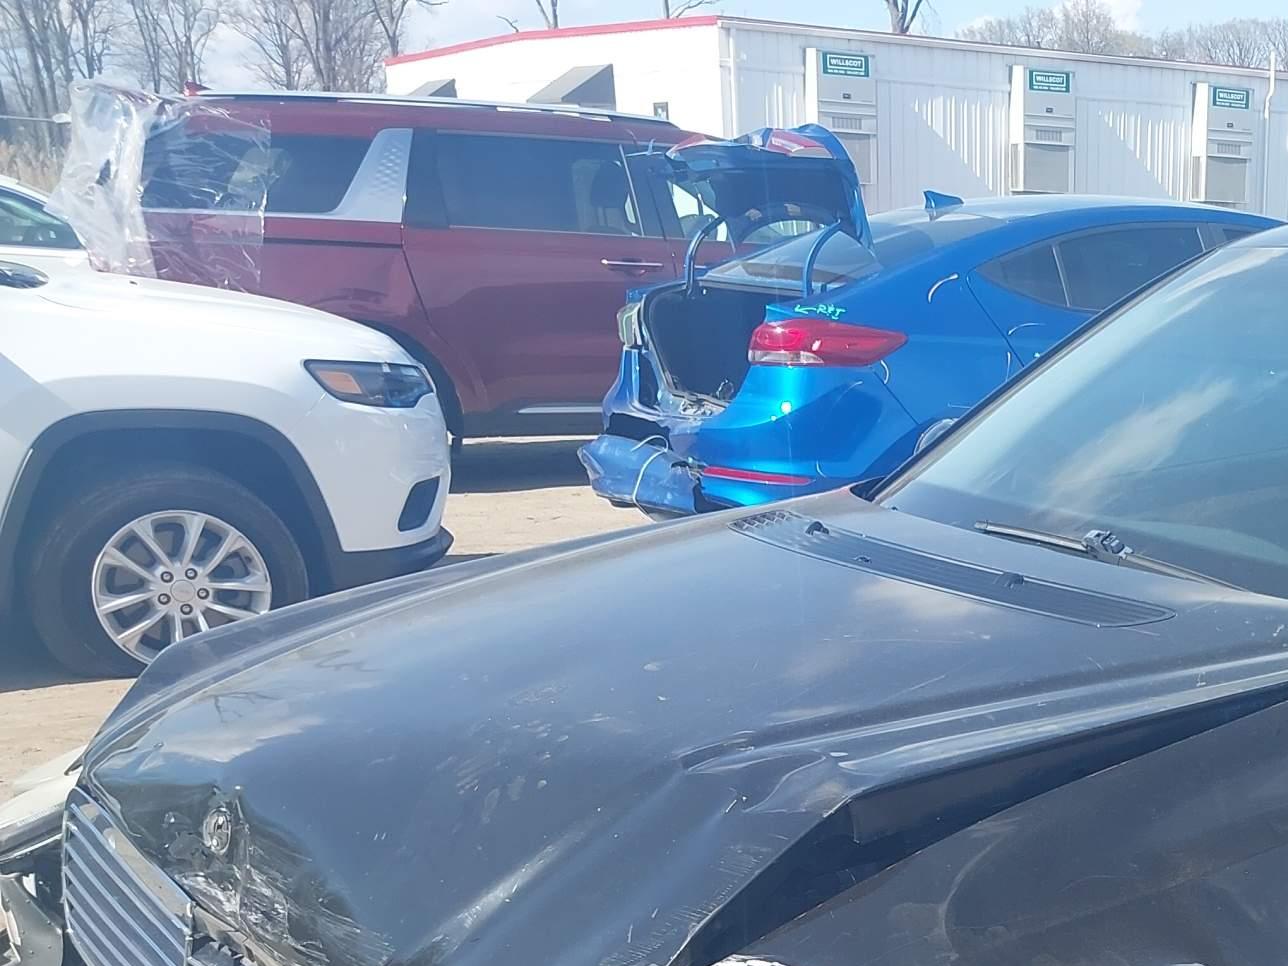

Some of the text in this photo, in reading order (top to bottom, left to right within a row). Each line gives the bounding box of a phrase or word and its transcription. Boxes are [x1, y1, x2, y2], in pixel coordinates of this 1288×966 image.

[830, 58, 862, 67] WILLSCOT
[1035, 75, 1063, 84] WILLSCOT
[1218, 92, 1244, 101] WILLSCOT
